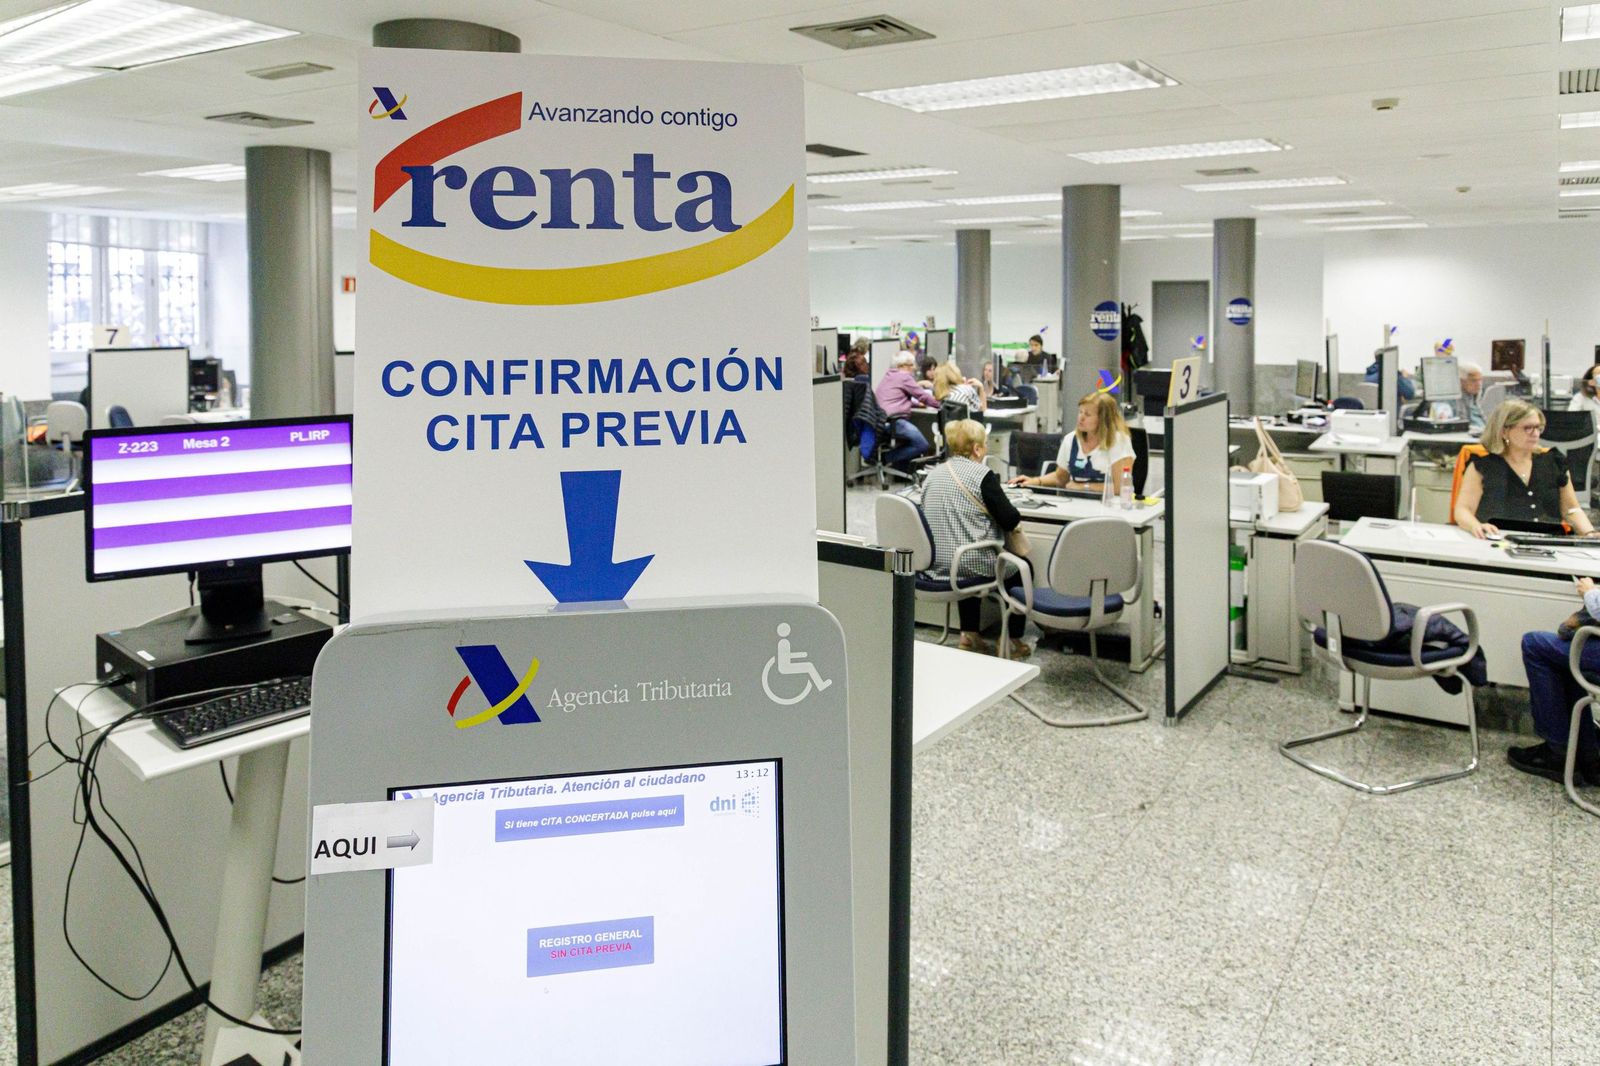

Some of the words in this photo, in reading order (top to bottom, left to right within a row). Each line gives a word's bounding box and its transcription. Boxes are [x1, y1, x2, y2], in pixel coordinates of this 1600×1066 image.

[528, 101, 654, 125] Avanzando
[660, 107, 738, 132] contigo
[400, 152, 742, 233] renta
[1090, 311, 1120, 323] rent
[105, 328, 119, 345] 7
[381, 347, 784, 398] CONFIRMACIÓN
[1180, 364, 1192, 400] 3
[426, 412, 545, 452] CITA
[561, 408, 748, 449] PREVIA
[118, 441, 159, 454] Z-223
[183, 438, 218, 450] Mesa
[220, 436, 231, 448] 2
[546, 683, 630, 713] Agencia
[636, 677, 733, 702] Tributaria
[490, 783, 558, 799] Tributaria.
[561, 778, 620, 793] Atención
[623, 776, 636, 788] al
[639, 771, 706, 787] ciudadano
[736, 768, 769, 779] 13:12
[516, 819, 539, 829] tiene
[540, 816, 563, 826] CITA
[565, 810, 629, 824] CONCERTADA
[630, 808, 656, 821] pulse
[314, 836, 377, 859] AQUI
[539, 934, 593, 949] REGISTRO
[594, 929, 643, 943] GENERAL
[550, 949, 567, 959] SIN
[569, 946, 593, 957] CITA
[595, 942, 632, 953] PREVIA
